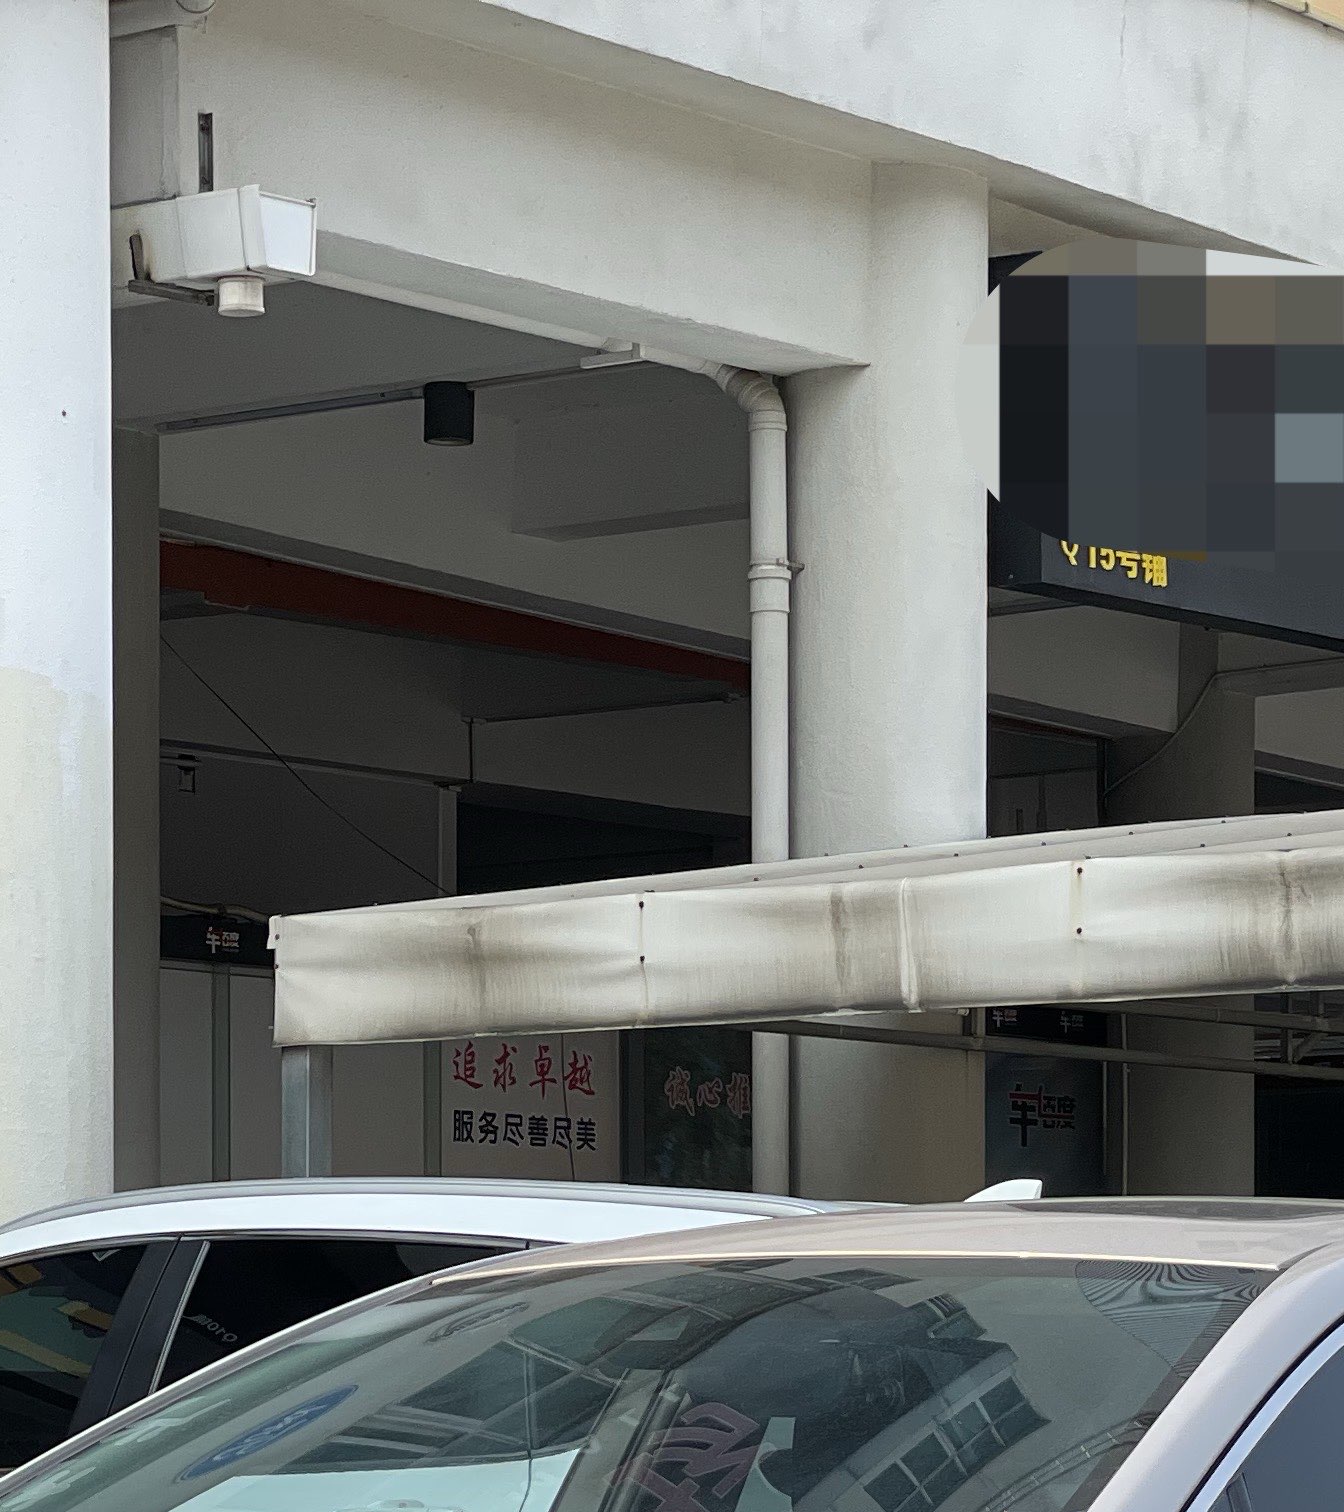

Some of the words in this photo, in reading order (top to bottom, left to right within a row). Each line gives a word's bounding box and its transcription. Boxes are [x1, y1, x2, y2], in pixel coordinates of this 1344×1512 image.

[453, 1041, 596, 1099] 追求卓越
[453, 1110, 596, 1151] 服务尽善尽美
